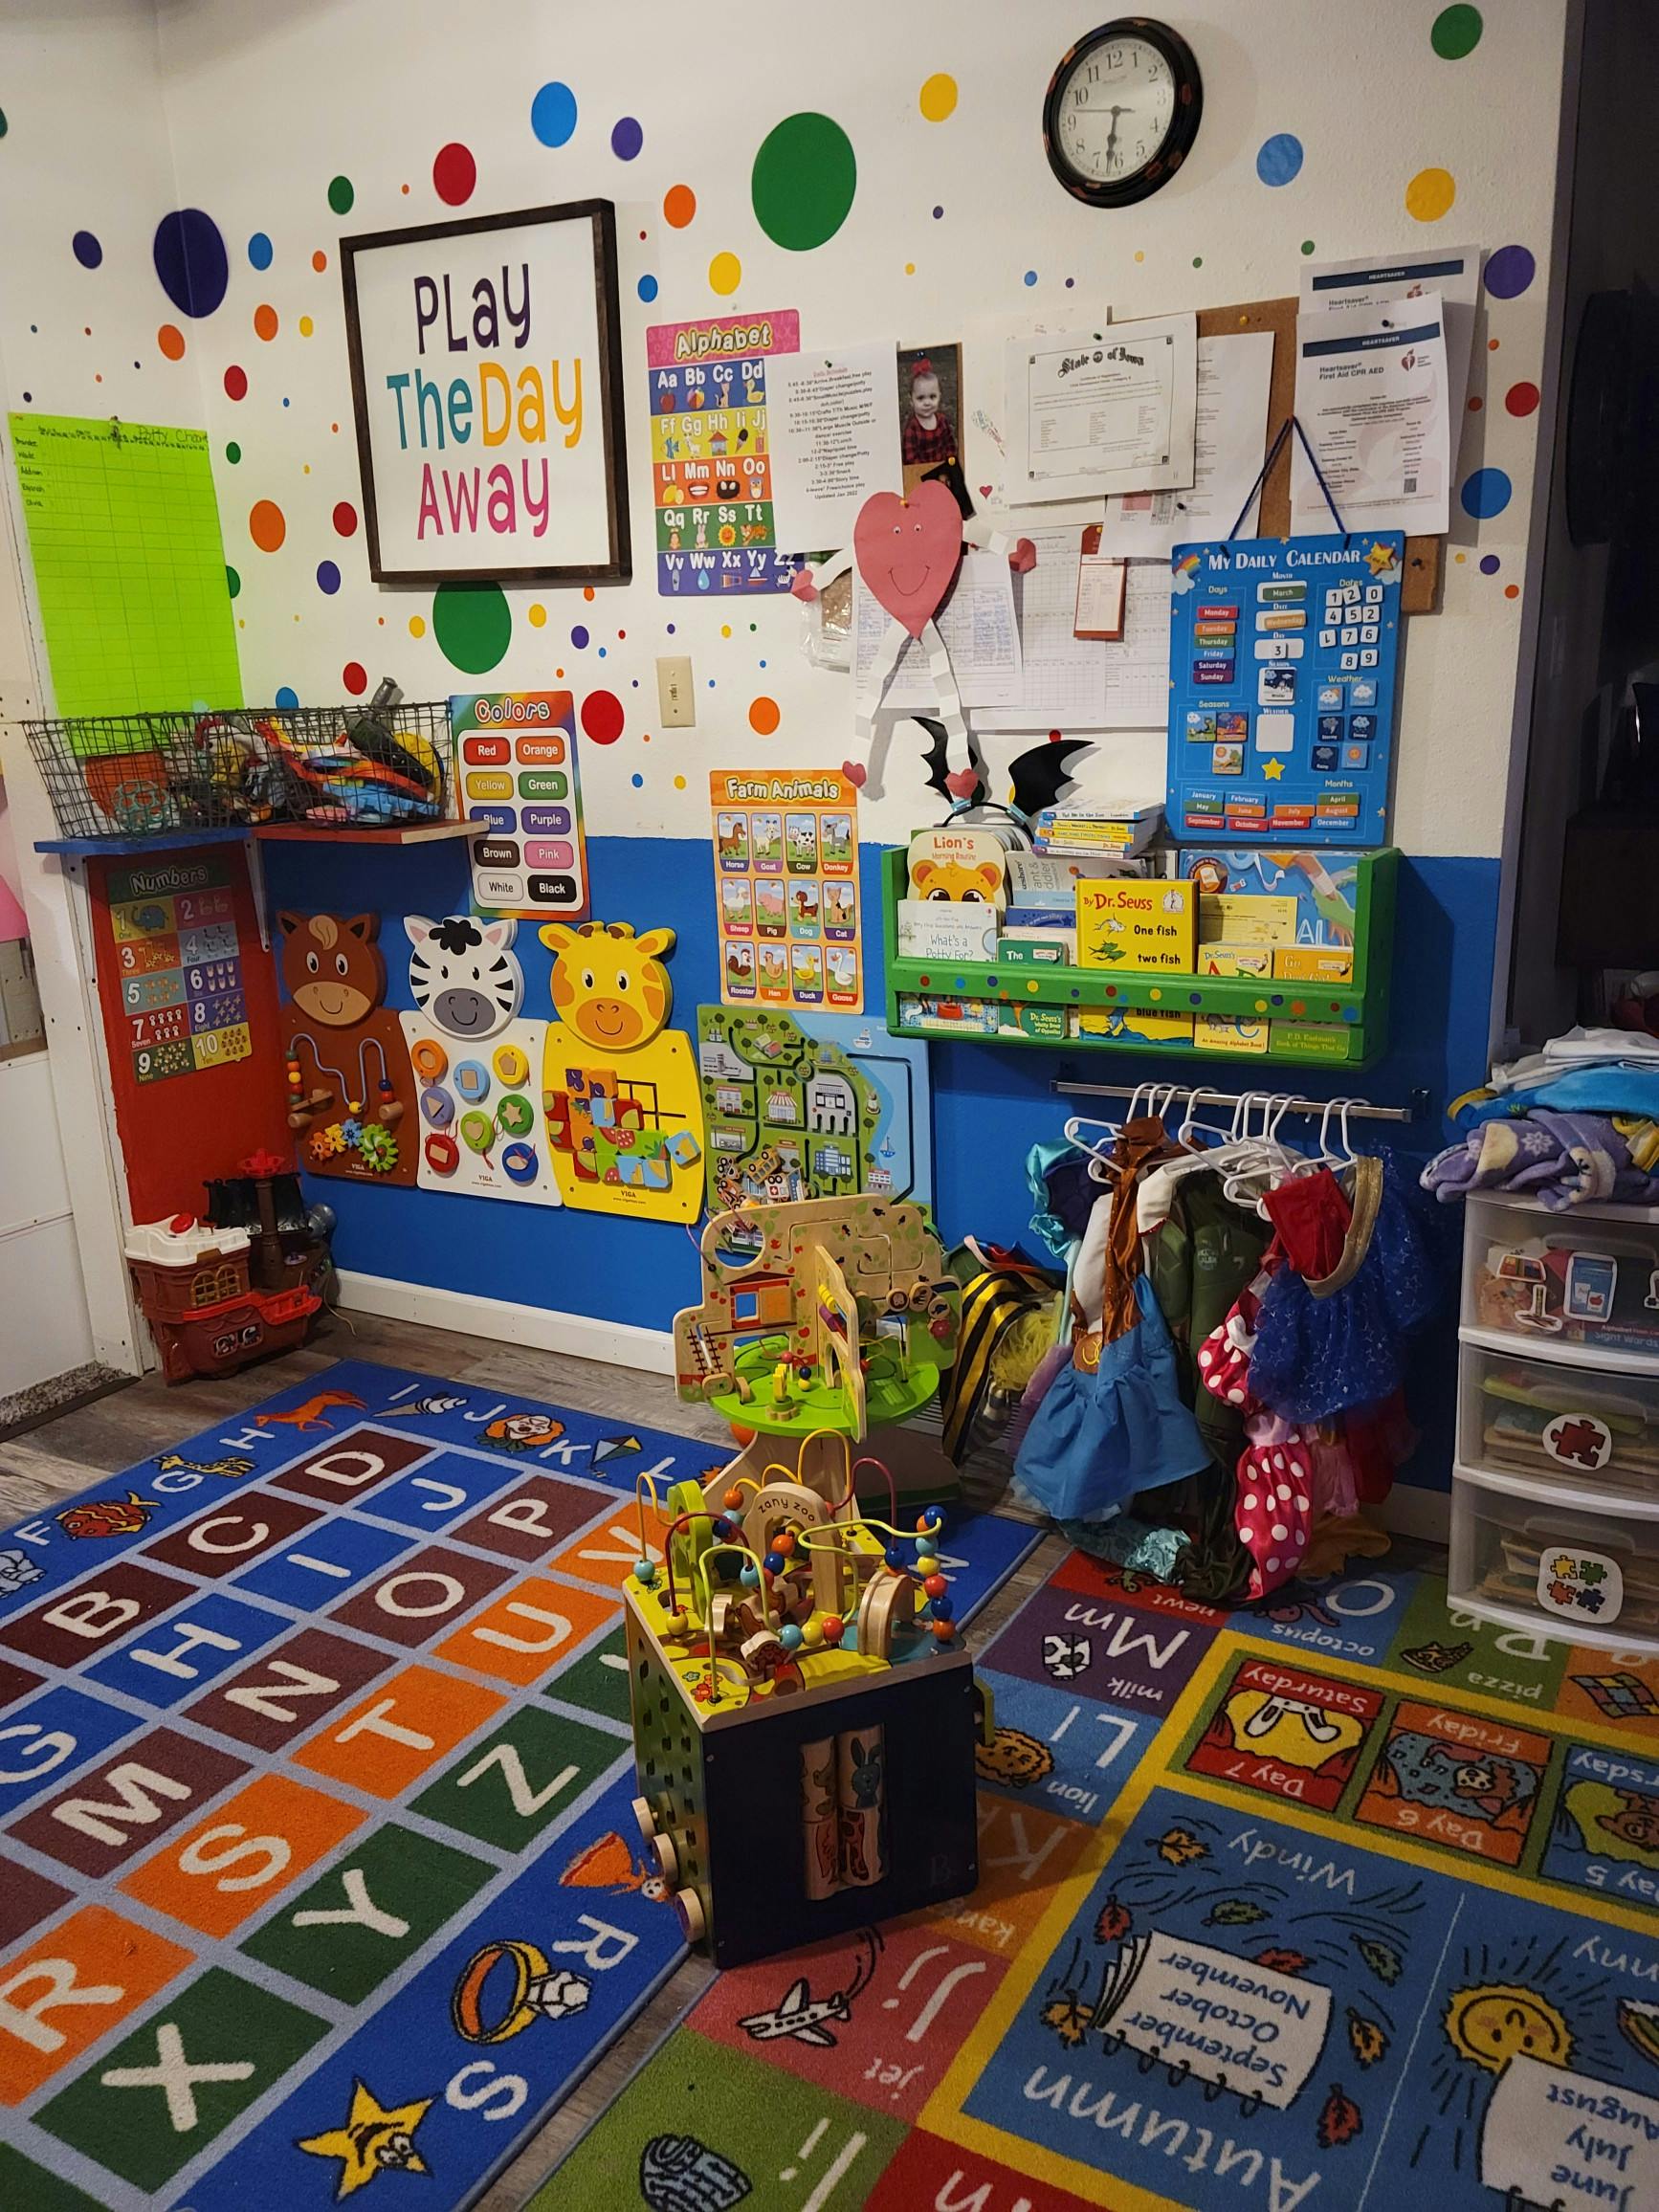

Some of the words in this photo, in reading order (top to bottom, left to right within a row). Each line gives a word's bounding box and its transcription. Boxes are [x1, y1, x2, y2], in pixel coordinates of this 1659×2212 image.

[1107, 51, 1123, 69] 12
[1087, 65, 1099, 83] 11
[1074, 87, 1088, 105] 10
[675, 323, 771, 359] Alphabet
[1058, 354, 1089, 378] State
[1108, 348, 1117, 360] of
[1118, 347, 1144, 365] Iowa
[658, 370, 677, 389] Aa
[685, 367, 705, 387] Bb
[713, 365, 734, 383] Cc
[741, 362, 763, 380] Dd
[387, 368, 473, 450] The
[478, 359, 582, 449] Day
[137, 425, 168, 443] Potty
[682, 416, 701, 436] Gg
[708, 413, 727, 430] Hh
[685, 462, 709, 479] Mm
[717, 460, 735, 477] Nn
[743, 457, 764, 476] Oo
[1208, 586, 1228, 594] Days
[475, 697, 550, 724] Colors
[478, 745, 497, 756] Red
[523, 744, 558, 758] Orange
[476, 780, 505, 790] Yellow
[528, 780, 558, 791] Green
[727, 778, 767, 799] Farm
[772, 779, 839, 801] Animals
[1192, 791, 1216, 801] January
[1231, 795, 1258, 804] February
[484, 814, 504, 825] Blue
[530, 813, 562, 827] Purple
[1188, 817, 1220, 827] September
[934, 836, 974, 850] Lion's
[483, 848, 512, 858] Brown
[539, 849, 560, 860] Pink
[726, 861, 744, 870] Horse
[796, 862, 811, 871] Cow
[824, 863, 849, 873] Donkey
[131, 866, 207, 895] Numbers
[489, 881, 514, 893] White
[540, 883, 565, 895] Black
[1084, 896, 1094, 906] By
[1095, 894, 1115, 909] Dr.
[1117, 892, 1153, 911] Seuss
[730, 924, 749, 934] Sheep
[767, 927, 778, 937] Pig
[799, 927, 813, 937] Dog
[1134, 925, 1154, 936] One
[1157, 925, 1177, 937] fish
[930, 935, 960, 946] What's
[962, 937, 967, 945] a
[187, 955, 200, 963] Four
[1006, 950, 1024, 960] The
[1138, 954, 1158, 963] two
[1161, 954, 1181, 964] fish
[127, 983, 140, 1004] 5
[730, 987, 755, 996] Rooster
[194, 1003, 206, 1023] 8
[1137, 1009, 1158, 1018] blue
[1161, 1009, 1181, 1018] fish
[132, 1019, 144, 1040] 7
[195, 1023, 210, 1032] Eight
[131, 1037, 151, 1049] Seven
[195, 1034, 218, 1057] 10
[138, 1052, 150, 1073] 9
[139, 1073, 153, 1082] Nine
[1593, 1332, 1621, 1340] Sight
[1624, 1334, 1659, 1347] Words
[304, 1449, 385, 1488] D
[488, 1498, 553, 1537] P
[759, 1497, 788, 1513] zany
[793, 1502, 815, 1521] zoo
[188, 1515, 271, 1555] C
[374, 1571, 465, 1616] O
[43, 1590, 141, 1638] B
[1271, 1624, 1376, 1657] octopus
[128, 1623, 242, 1679] H
[225, 1660, 340, 1722] N
[1107, 1676, 1164, 1702] milk
[1245, 1666, 1368, 1714] Saturday
[1468, 1671, 1543, 1700] pizza
[1427, 1714, 1520, 1755] Friday
[1225, 1761, 1240, 1778] 7
[456, 1744, 580, 1817] Z
[1251, 1764, 1305, 1798] Day
[1047, 1781, 1099, 1815] lion
[1398, 1809, 1420, 1826] 6
[1427, 1818, 1483, 1850] Day
[1228, 1827, 1356, 1895] Windy
[1159, 1951, 1311, 2021] November
[1160, 1987, 1279, 2044] October
[1122, 2009, 1288, 2089] September
[100, 2023, 255, 2132] X
[863, 2057, 924, 2100] jet
[1023, 2065, 1322, 2212] Autumn
[1565, 2123, 1633, 2171] July
